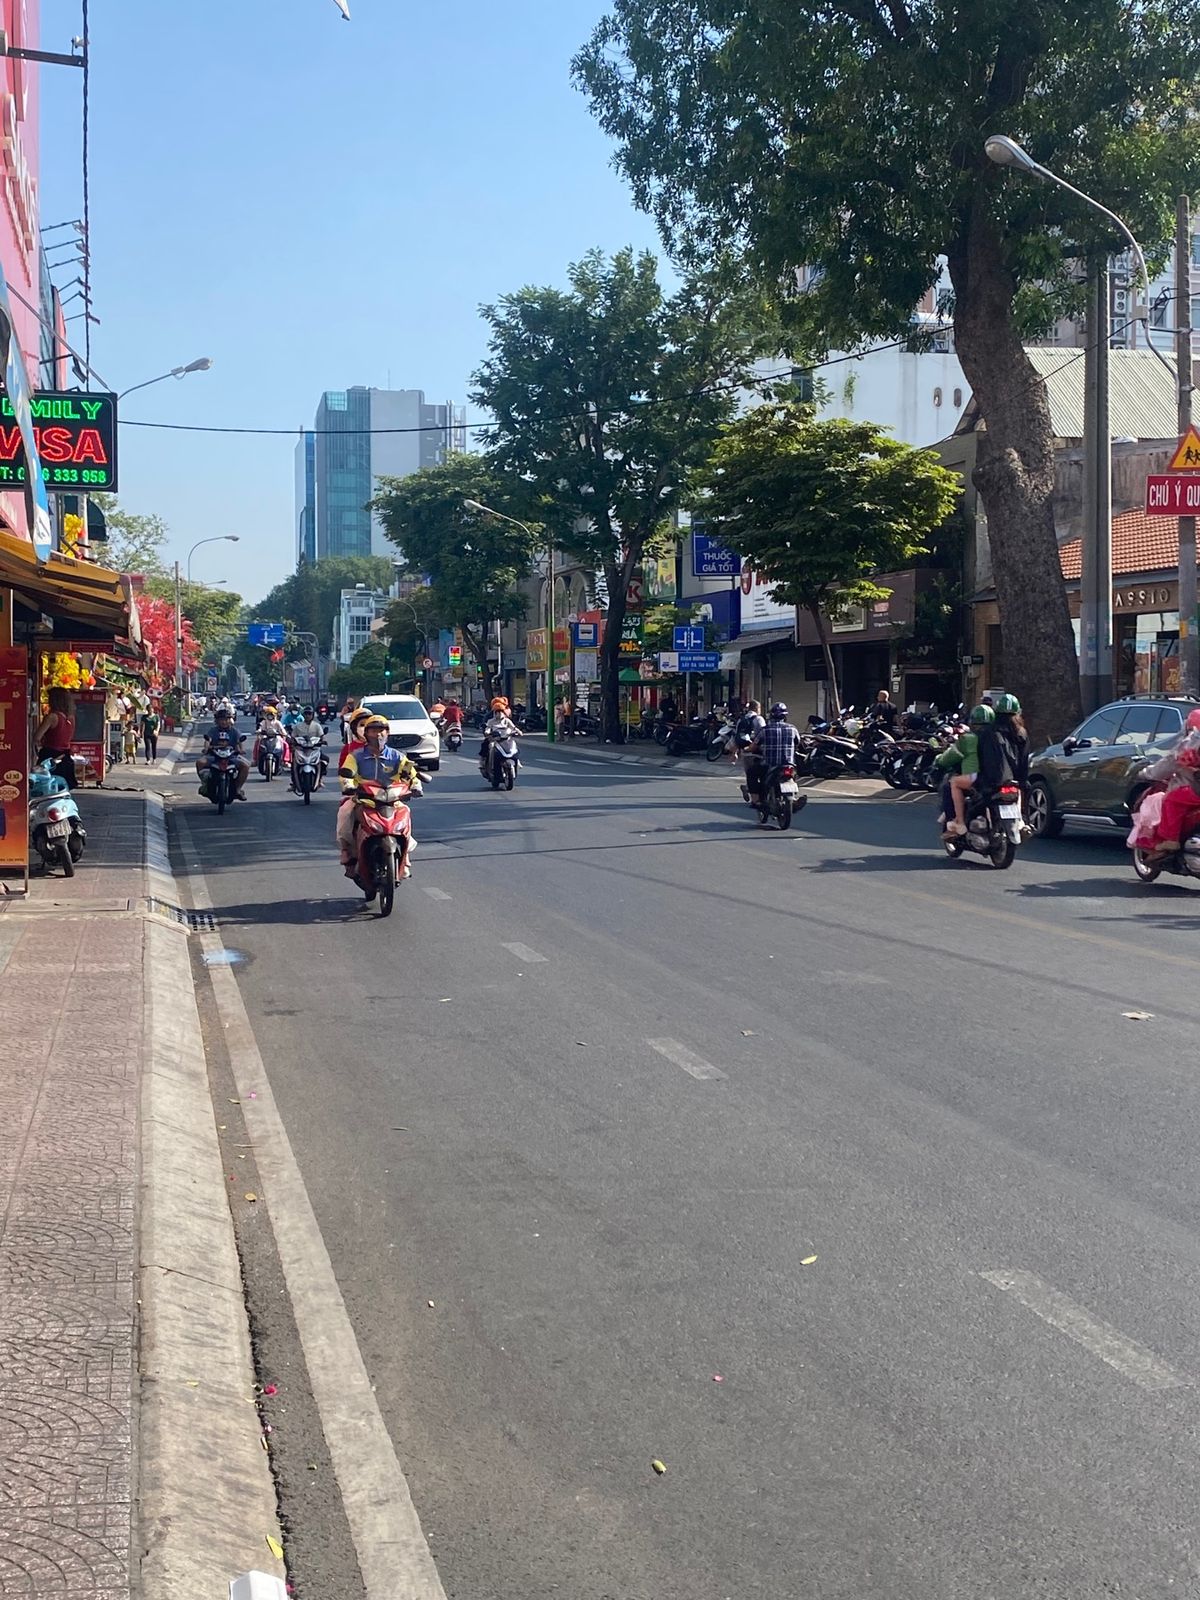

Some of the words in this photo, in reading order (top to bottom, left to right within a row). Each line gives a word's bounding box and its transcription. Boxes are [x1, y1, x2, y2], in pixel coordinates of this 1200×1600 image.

[2, 398, 102, 420] EMILY
[17, 467, 50, 481] 06
[53, 469, 78, 482] 333
[82, 469, 107, 483] 958
[1149, 480, 1169, 507] CHÚ
[1174, 480, 1182, 507] Ý
[703, 549, 732, 560] THUỐC
[702, 562, 717, 572] GIÁ
[718, 561, 734, 572] TỐT
